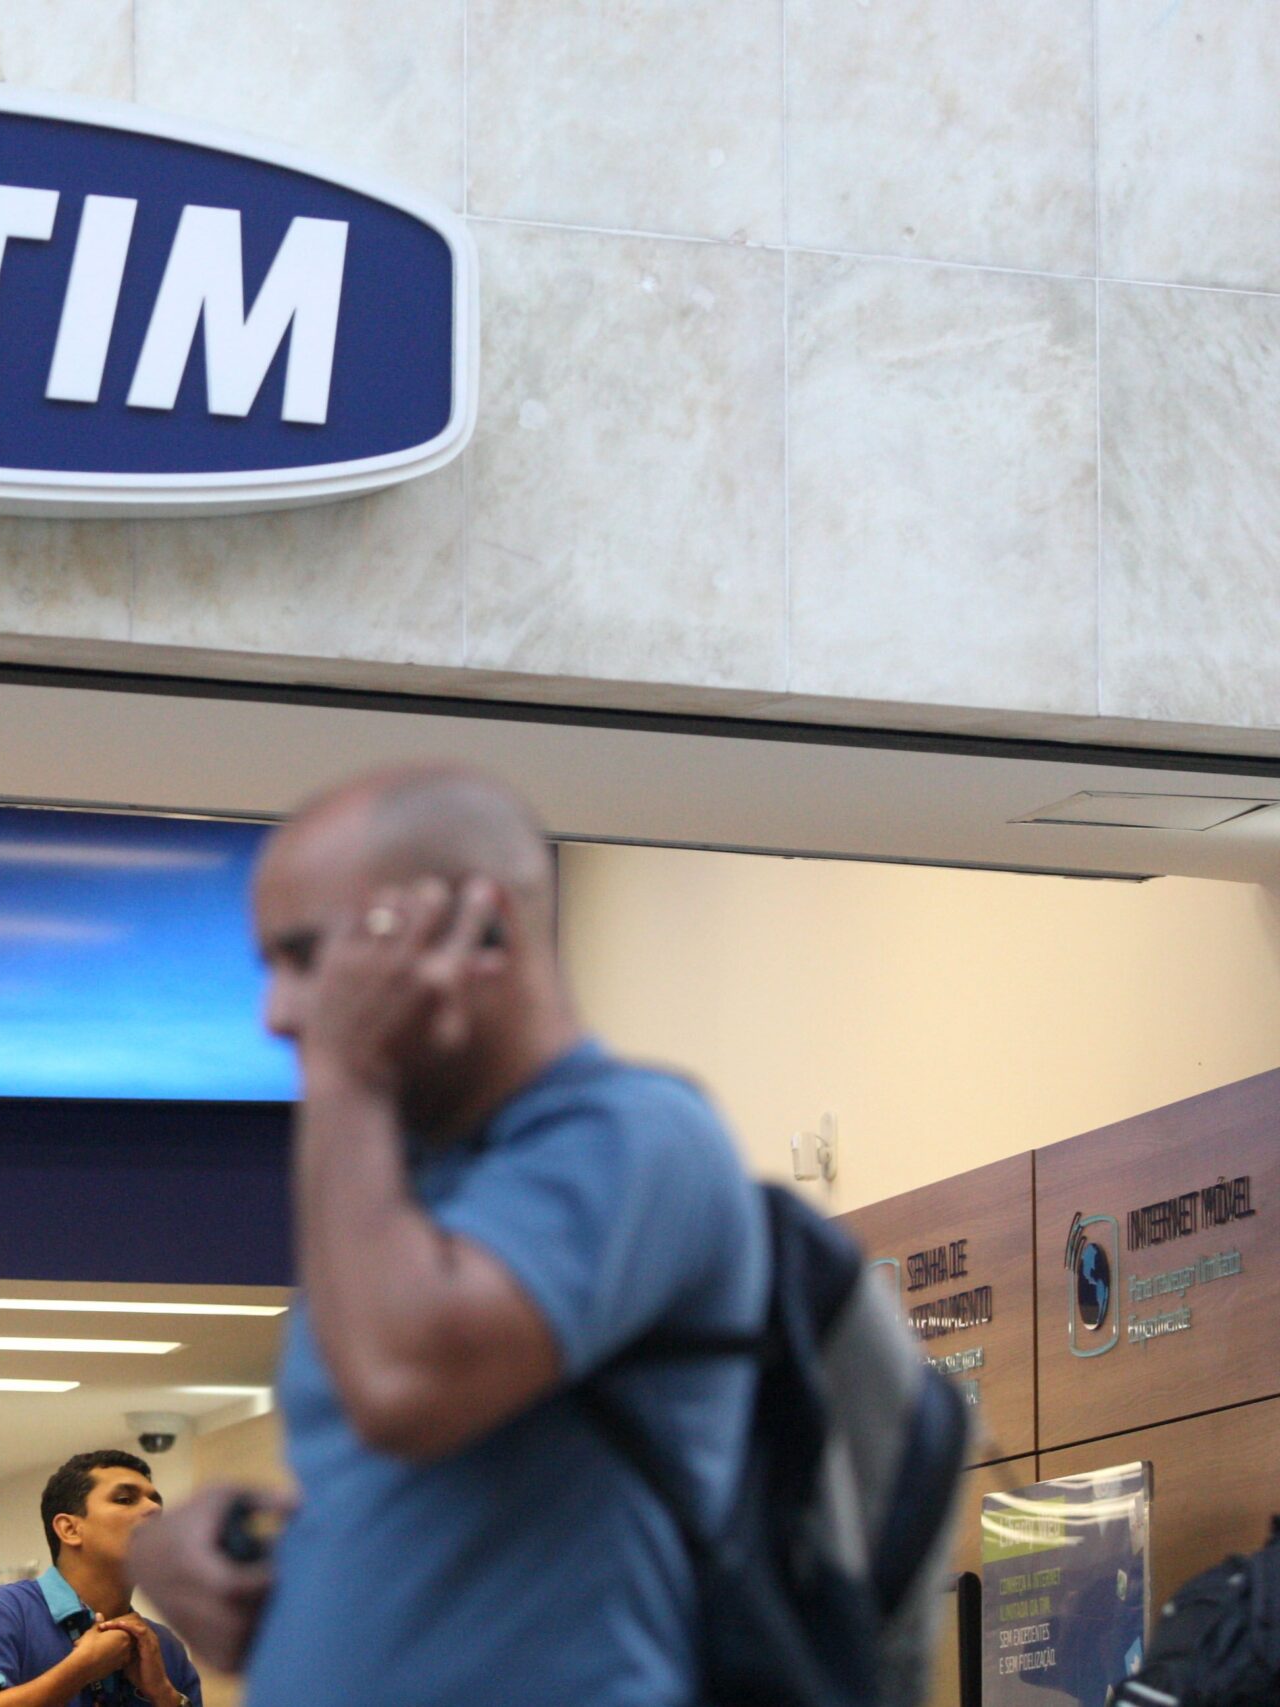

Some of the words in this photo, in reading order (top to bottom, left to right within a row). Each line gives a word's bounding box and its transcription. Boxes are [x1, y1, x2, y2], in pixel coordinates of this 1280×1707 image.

[1127, 1191, 1199, 1251] INTERNET
[1201, 1175, 1256, 1230] MÓVEL
[907, 1246, 948, 1292] SENHA
[949, 1239, 968, 1279] DE
